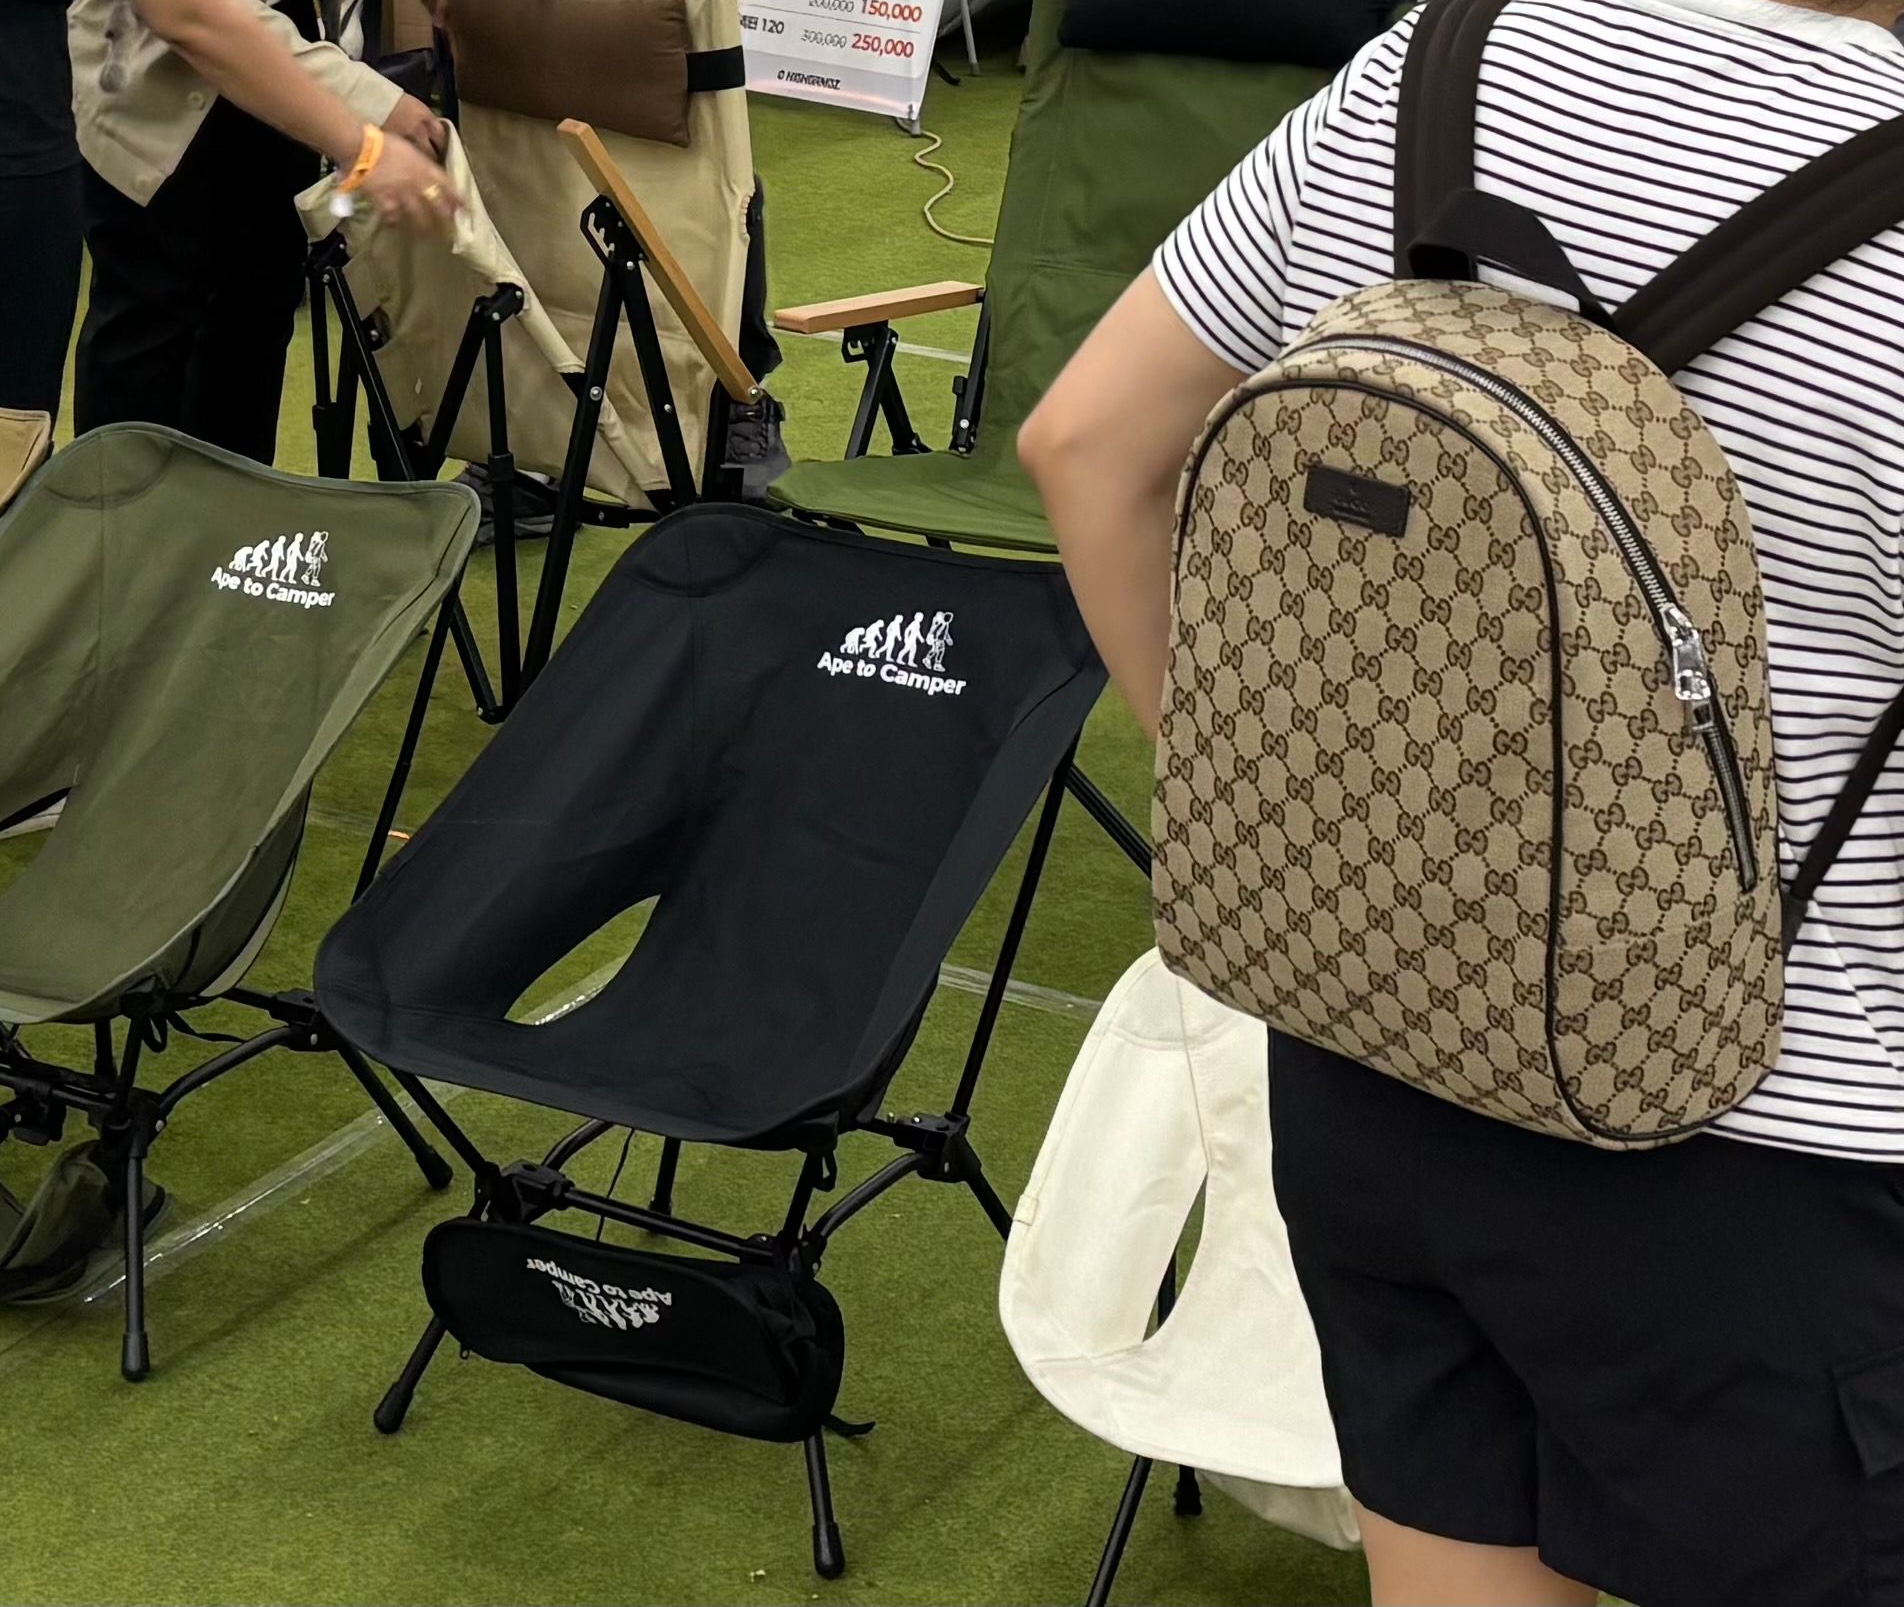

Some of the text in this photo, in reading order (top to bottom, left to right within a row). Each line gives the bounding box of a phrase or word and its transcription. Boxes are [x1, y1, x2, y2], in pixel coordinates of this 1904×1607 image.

[761, 18, 785, 35] 120
[851, 33, 914, 58] 250,000
[210, 566, 335, 609] Ape to Camper
[817, 650, 967, 697] Ape to Camper
[525, 1257, 672, 1306] Ape to Camper
